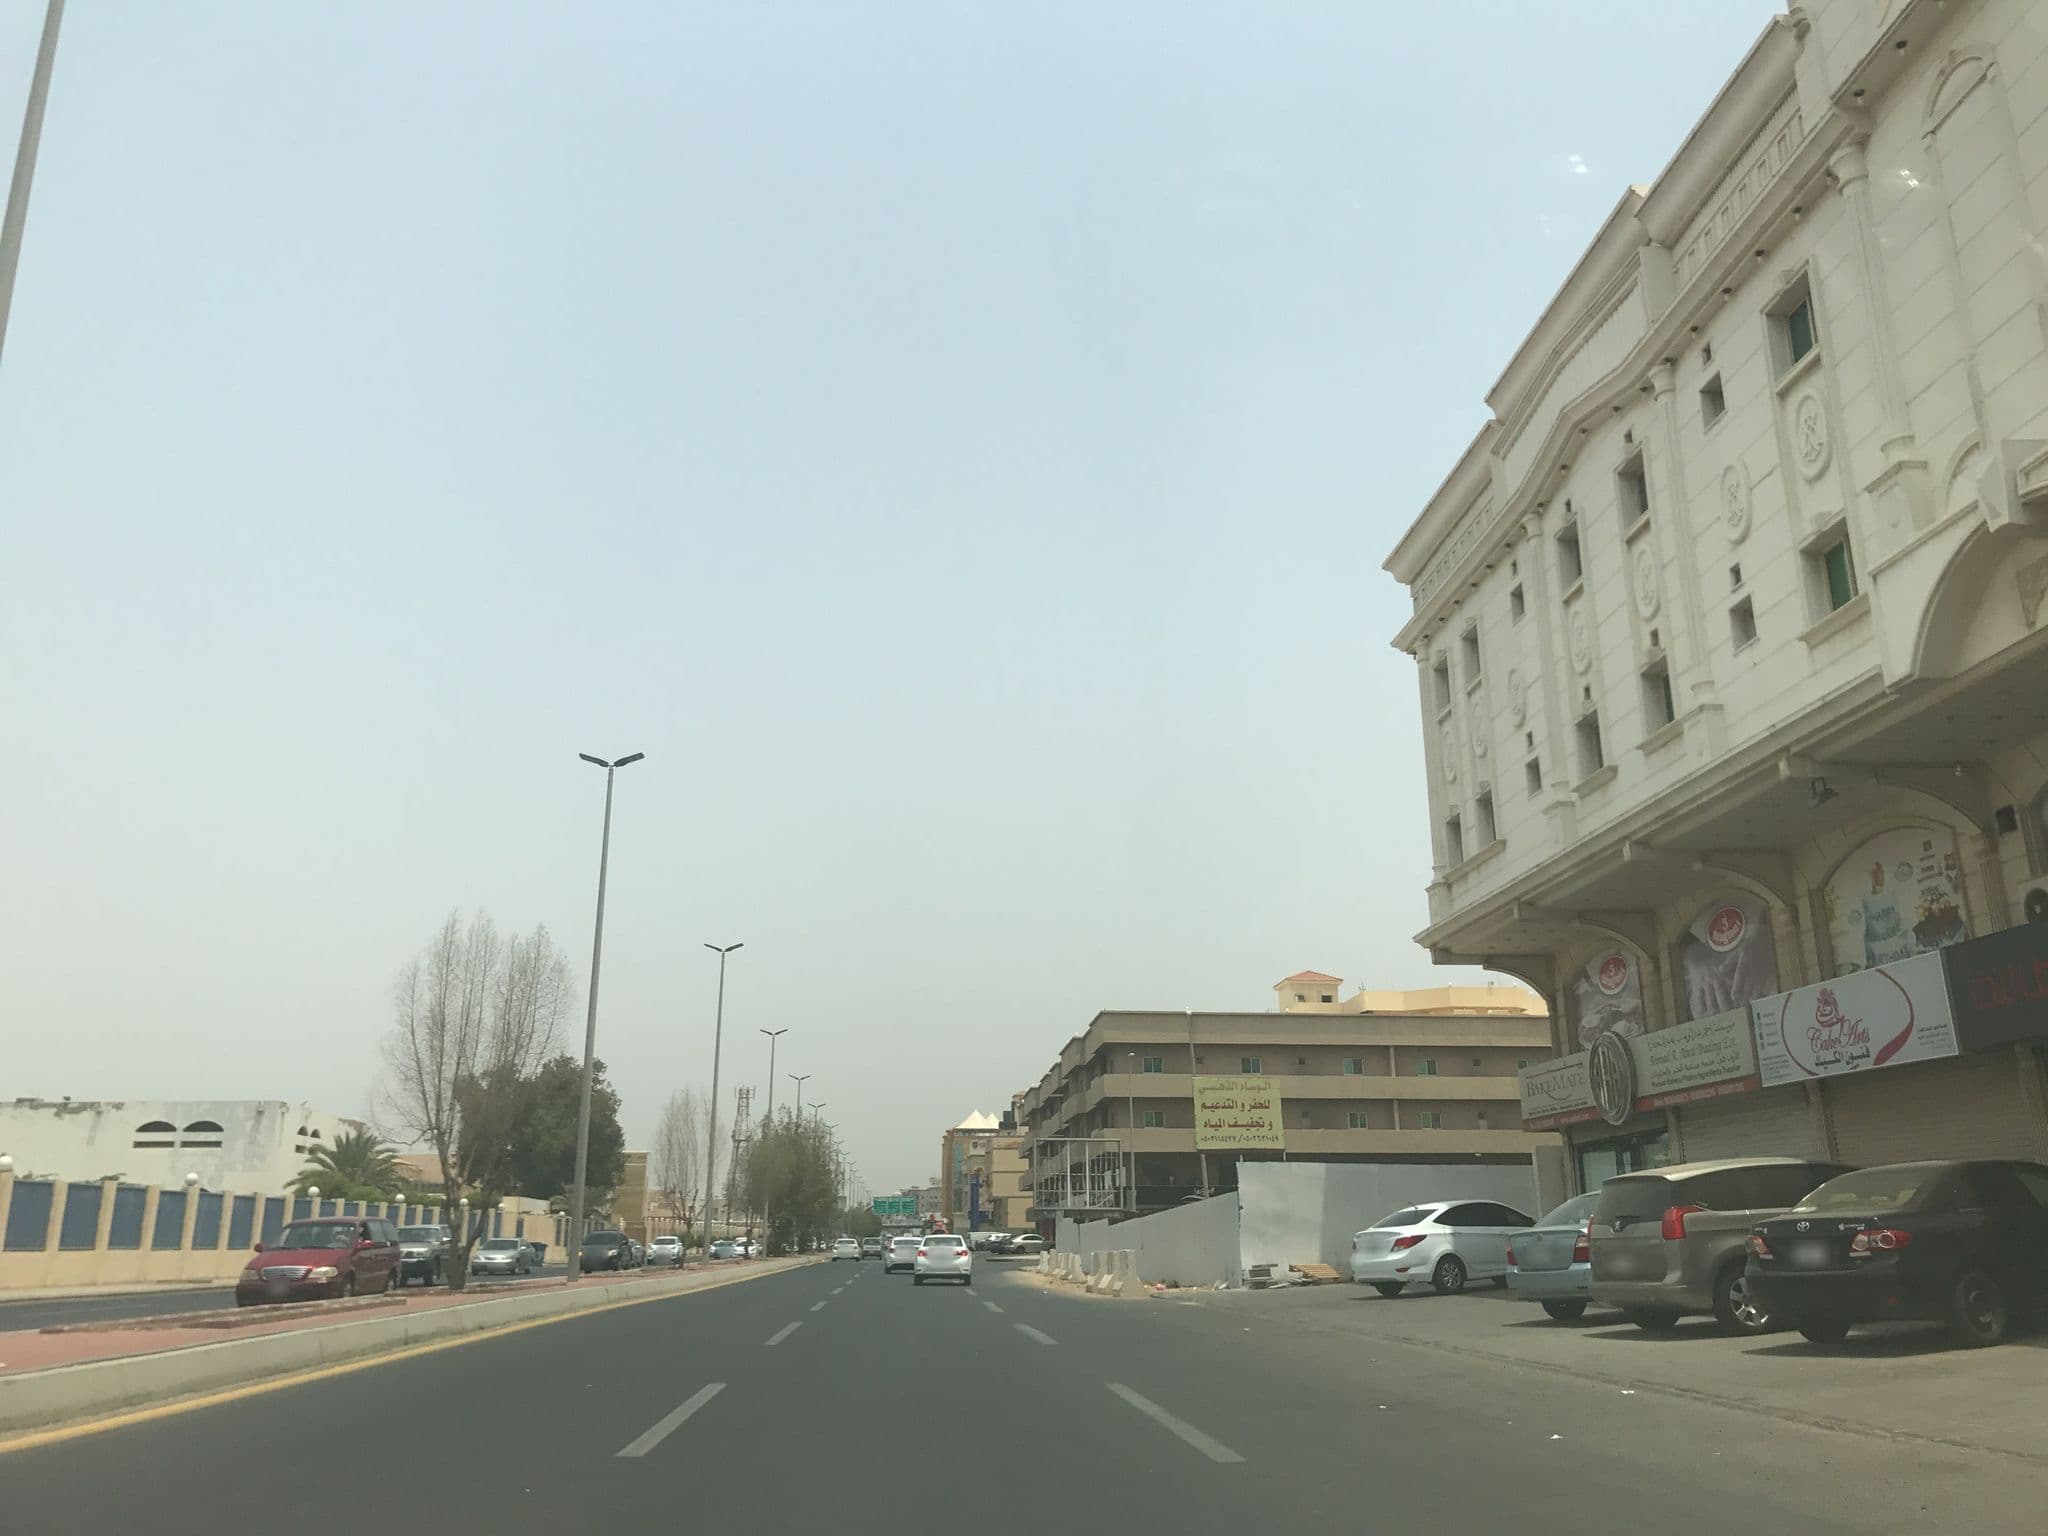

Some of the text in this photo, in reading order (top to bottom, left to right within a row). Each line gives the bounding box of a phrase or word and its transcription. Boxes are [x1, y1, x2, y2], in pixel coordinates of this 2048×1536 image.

[1807, 1026, 1841, 1053] Cake
[1840, 1018, 1870, 1048] Arts
[1200, 1098, 1238, 1113] التدعيم
[1248, 1098, 1271, 1112] للحفر
[1203, 1116, 1273, 1132] و تجفيف المياه
